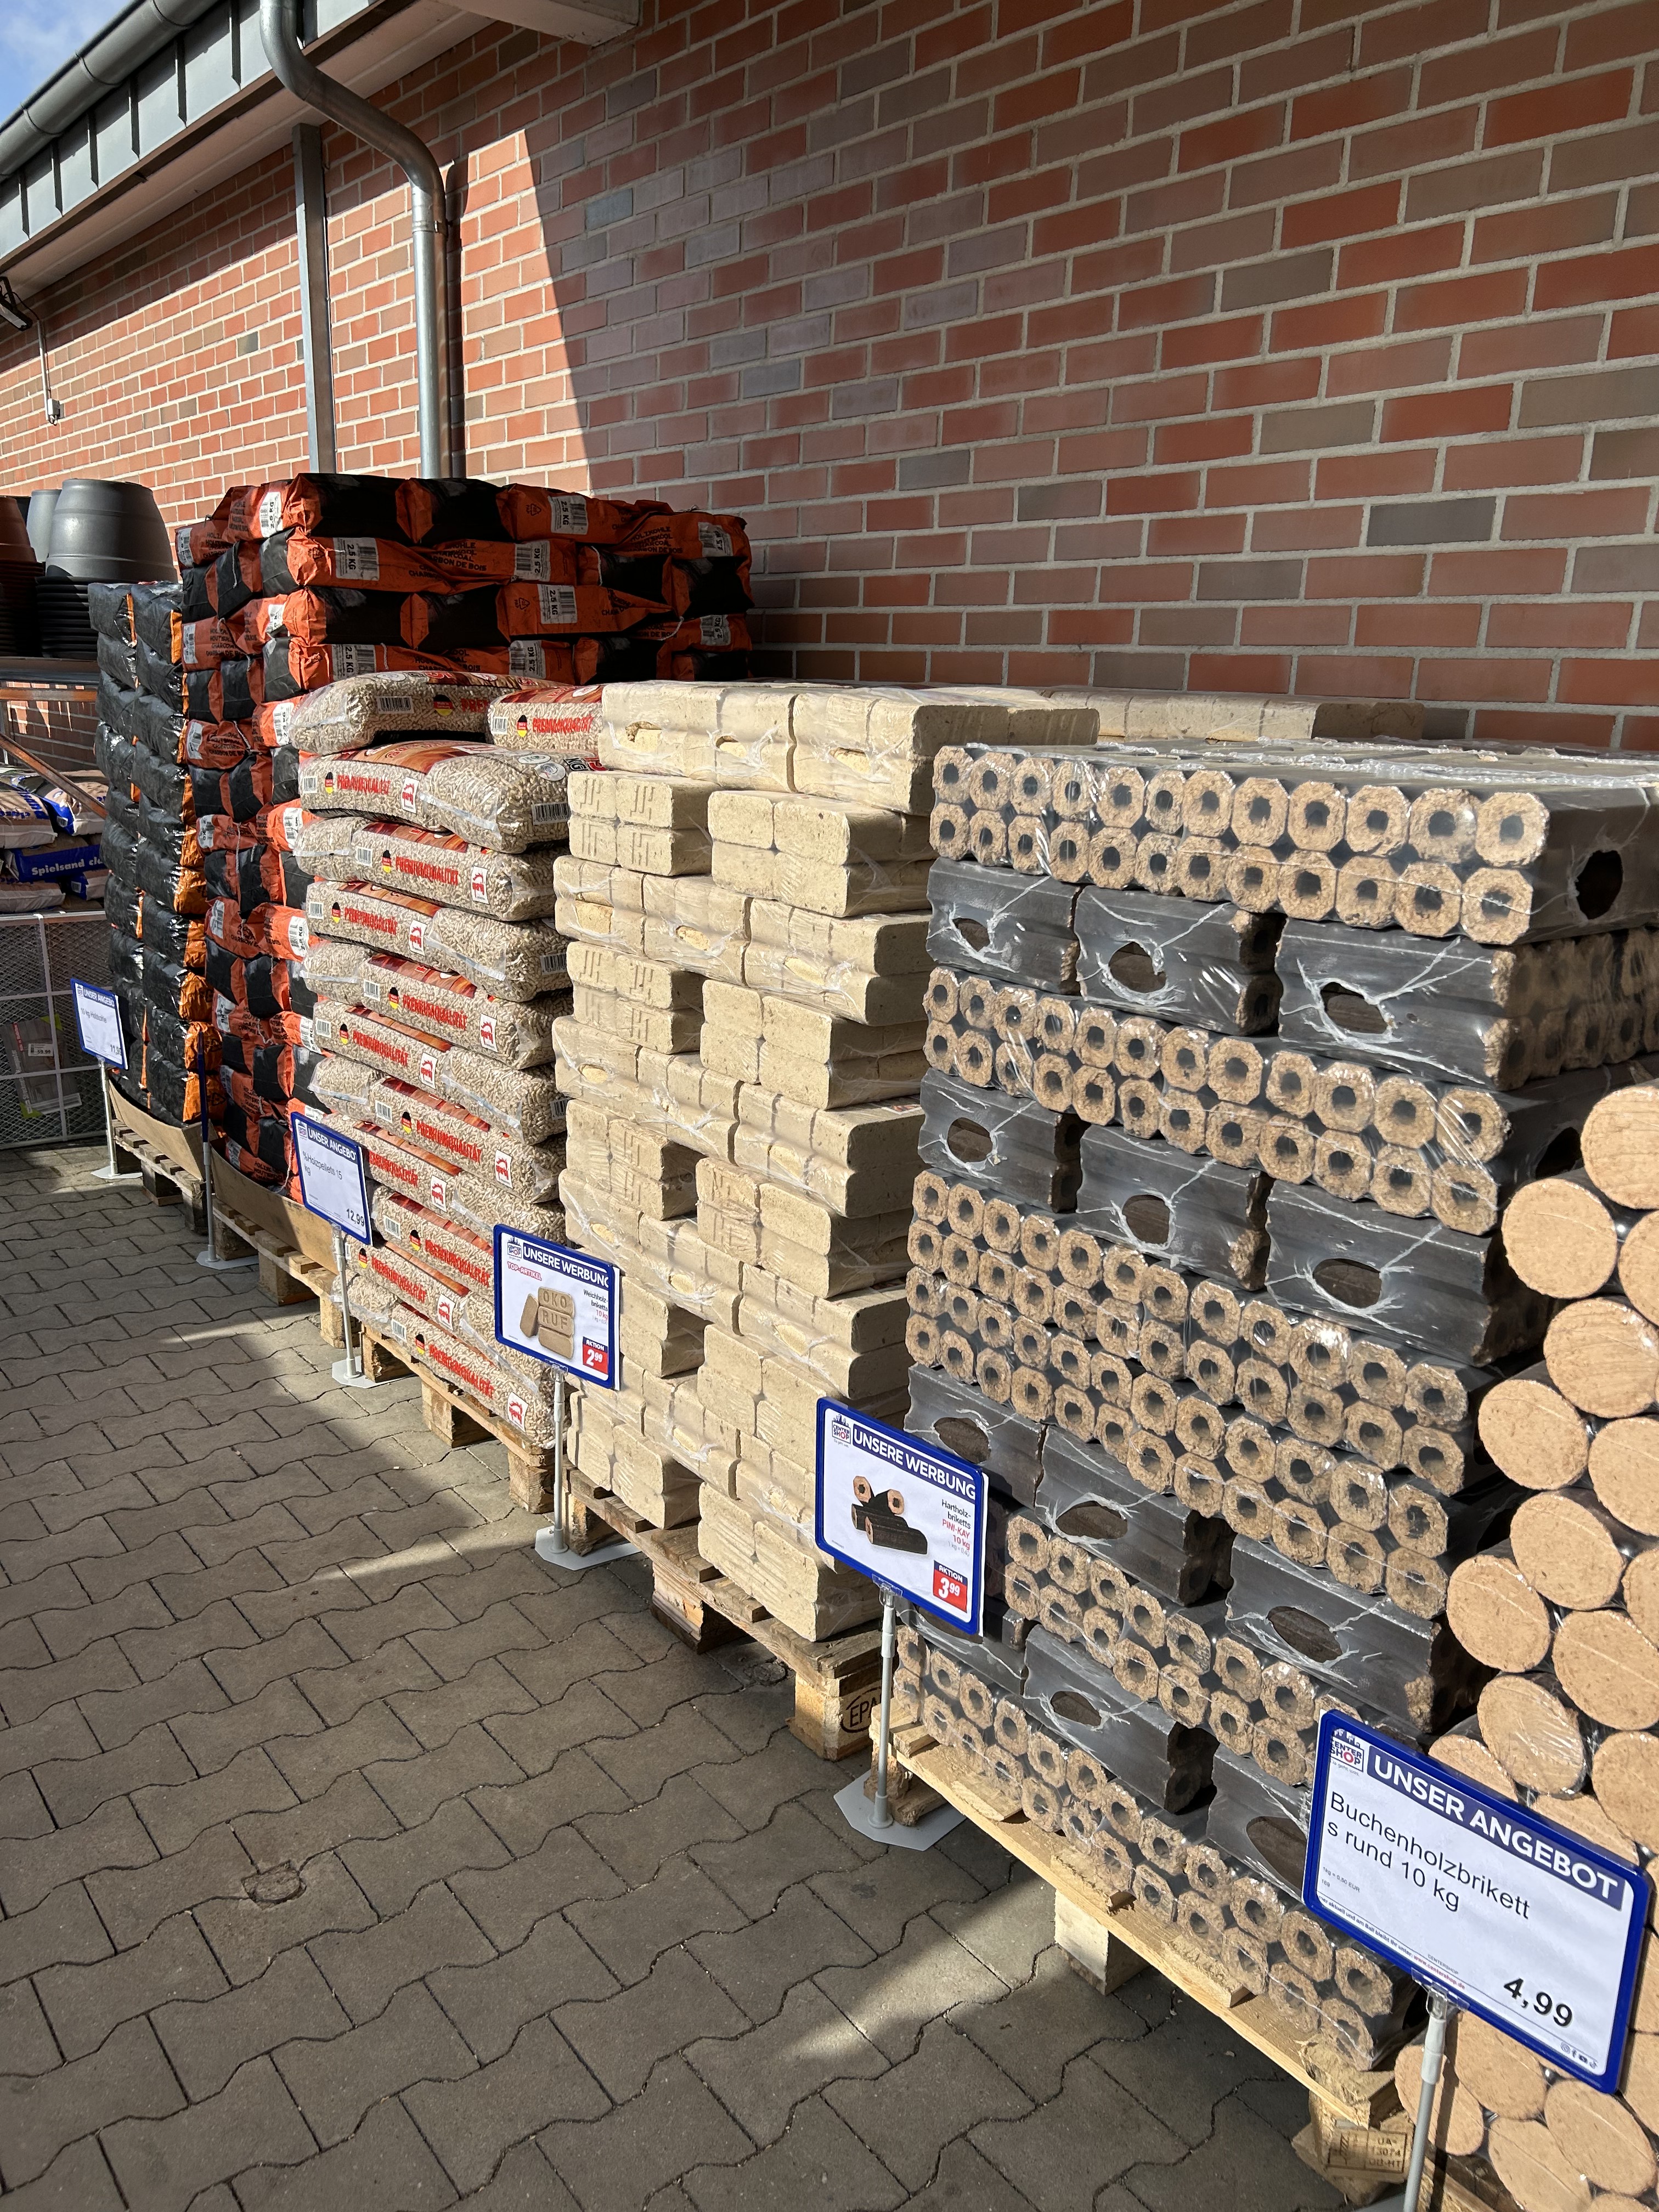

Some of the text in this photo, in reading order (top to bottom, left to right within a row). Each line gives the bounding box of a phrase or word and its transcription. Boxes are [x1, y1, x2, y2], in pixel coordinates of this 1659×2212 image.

[562, 514, 569, 526] KG
[534, 548, 540, 559] KG
[348, 558, 357, 571] KG
[468, 563, 487, 571] BOIS
[551, 605, 558, 616] KG
[528, 646, 534, 657] KG
[346, 662, 354, 673] KG
[563, 758, 589, 771] KG
[31, 859, 85, 876] Spielsand
[308, 1128, 330, 1148] UNSER
[330, 1139, 357, 1161] ANGEBO
[304, 1163, 311, 1176] kg
[336, 1169, 342, 1180] 15
[347, 1208, 364, 1227] 12,99
[524, 1246, 561, 1270] UNSERE
[507, 1261, 543, 1281] TOP-ARTIKEL
[583, 1289, 608, 1304] Weichholz-
[542, 1310, 568, 1330] RUF
[602, 1312, 608, 1321] kg
[586, 1339, 605, 1351] AKTION
[834, 1428, 850, 1440] SHOP
[854, 1428, 976, 1500] UNSERE WERBUNG
[941, 1499, 971, 1518] Hartholz-
[942, 1519, 970, 1539] PINI-KAY
[947, 1511, 971, 1530] briketts
[952, 1534, 970, 1551] 10 kg
[939, 1565, 963, 1583] AKTION
[849, 1697, 878, 1727] EPA
[1330, 1746, 1361, 1765] SHOP
[1374, 1754, 1618, 1899] UNSER ANGEBOT
[1330, 1791, 1530, 1920] Buchenholzbrikett
[1327, 1821, 1459, 1912] s rund 10 kg
[1348, 1882, 1361, 1893] EUR
[1346, 1912, 1356, 1921] und
[1356, 1918, 1364, 1927] am
[1413, 1955, 1466, 1990] www.centershop.de
[1503, 1977, 1573, 2028] 4,99
